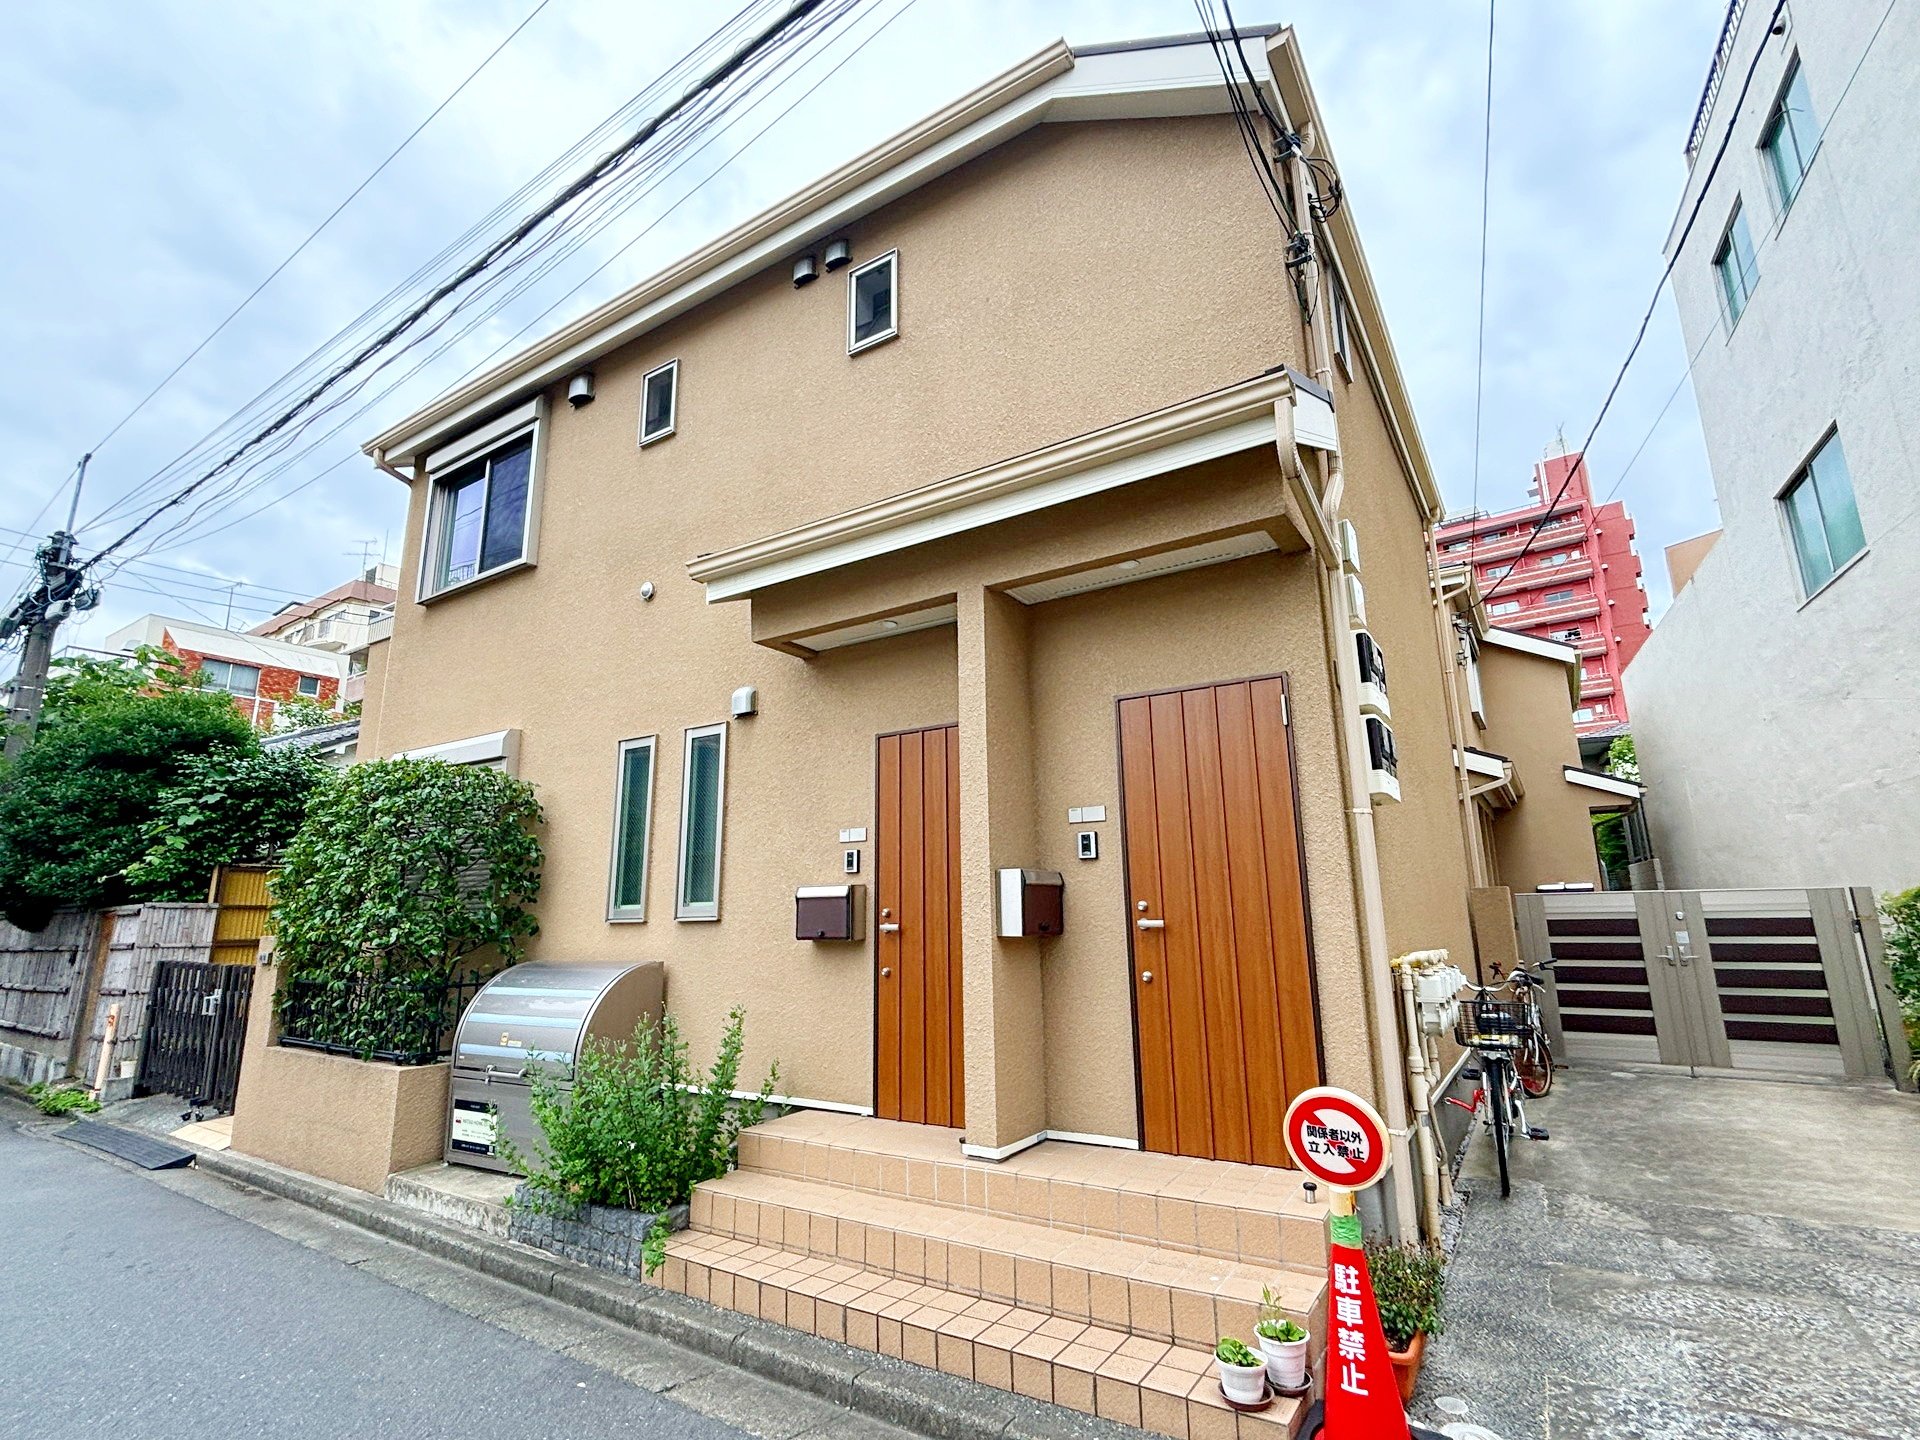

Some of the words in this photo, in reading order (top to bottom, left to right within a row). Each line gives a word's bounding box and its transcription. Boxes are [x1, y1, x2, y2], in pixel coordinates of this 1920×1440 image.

[1306, 1125, 1362, 1144] 関係者以外
[1308, 1141, 1365, 1160] 立入禁止
[1334, 1263, 1369, 1396] 駐車禁止
